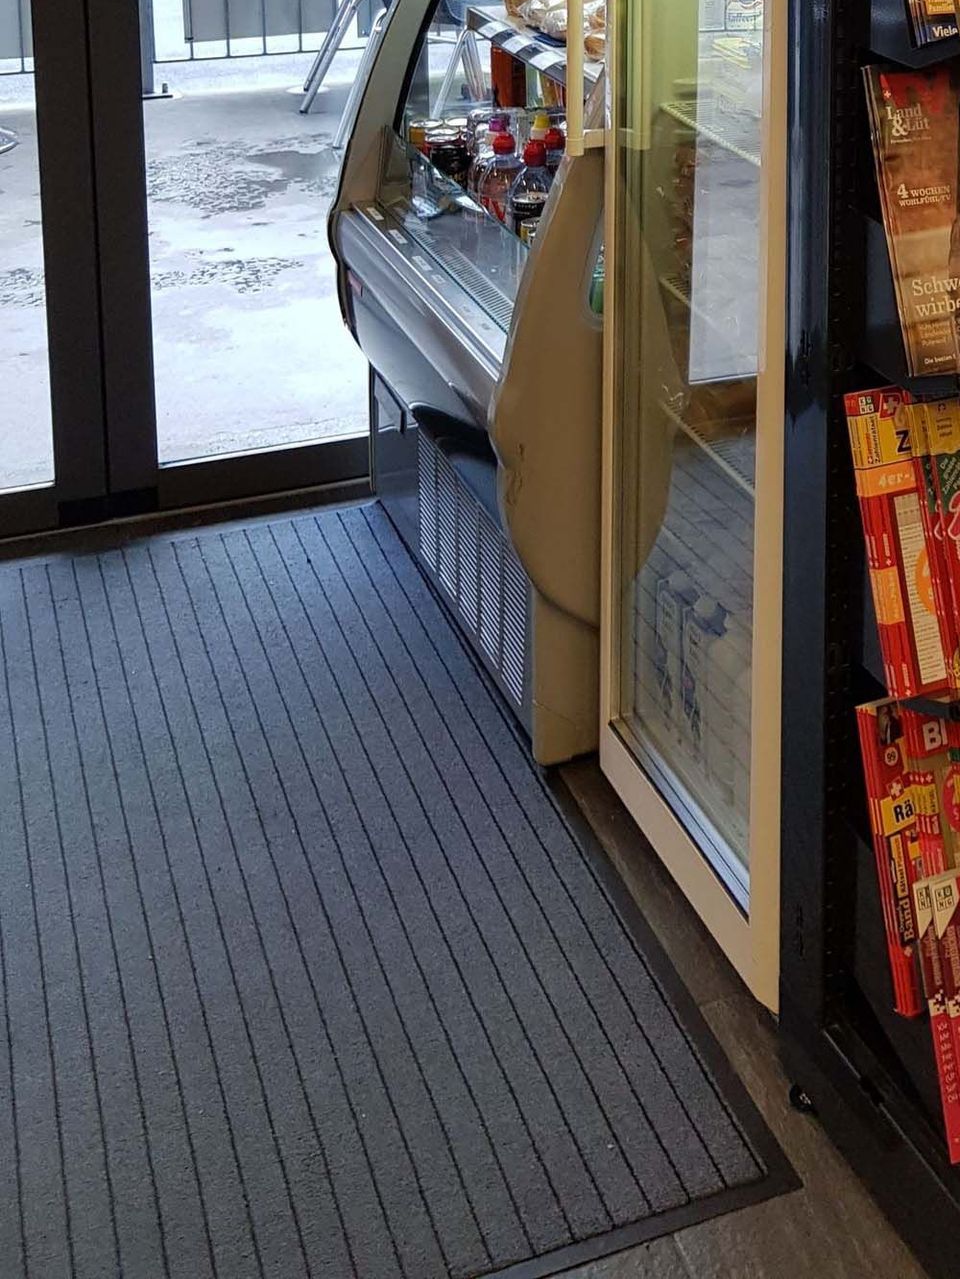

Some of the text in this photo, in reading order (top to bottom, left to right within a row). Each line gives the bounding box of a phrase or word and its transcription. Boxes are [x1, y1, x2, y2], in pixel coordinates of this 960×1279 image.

[886, 103, 923, 121] Land
[891, 120, 909, 137] &
[897, 183, 951, 200] 4 WOCHEN
[896, 429, 913, 454] Z
[894, 799, 915, 823] Rä
